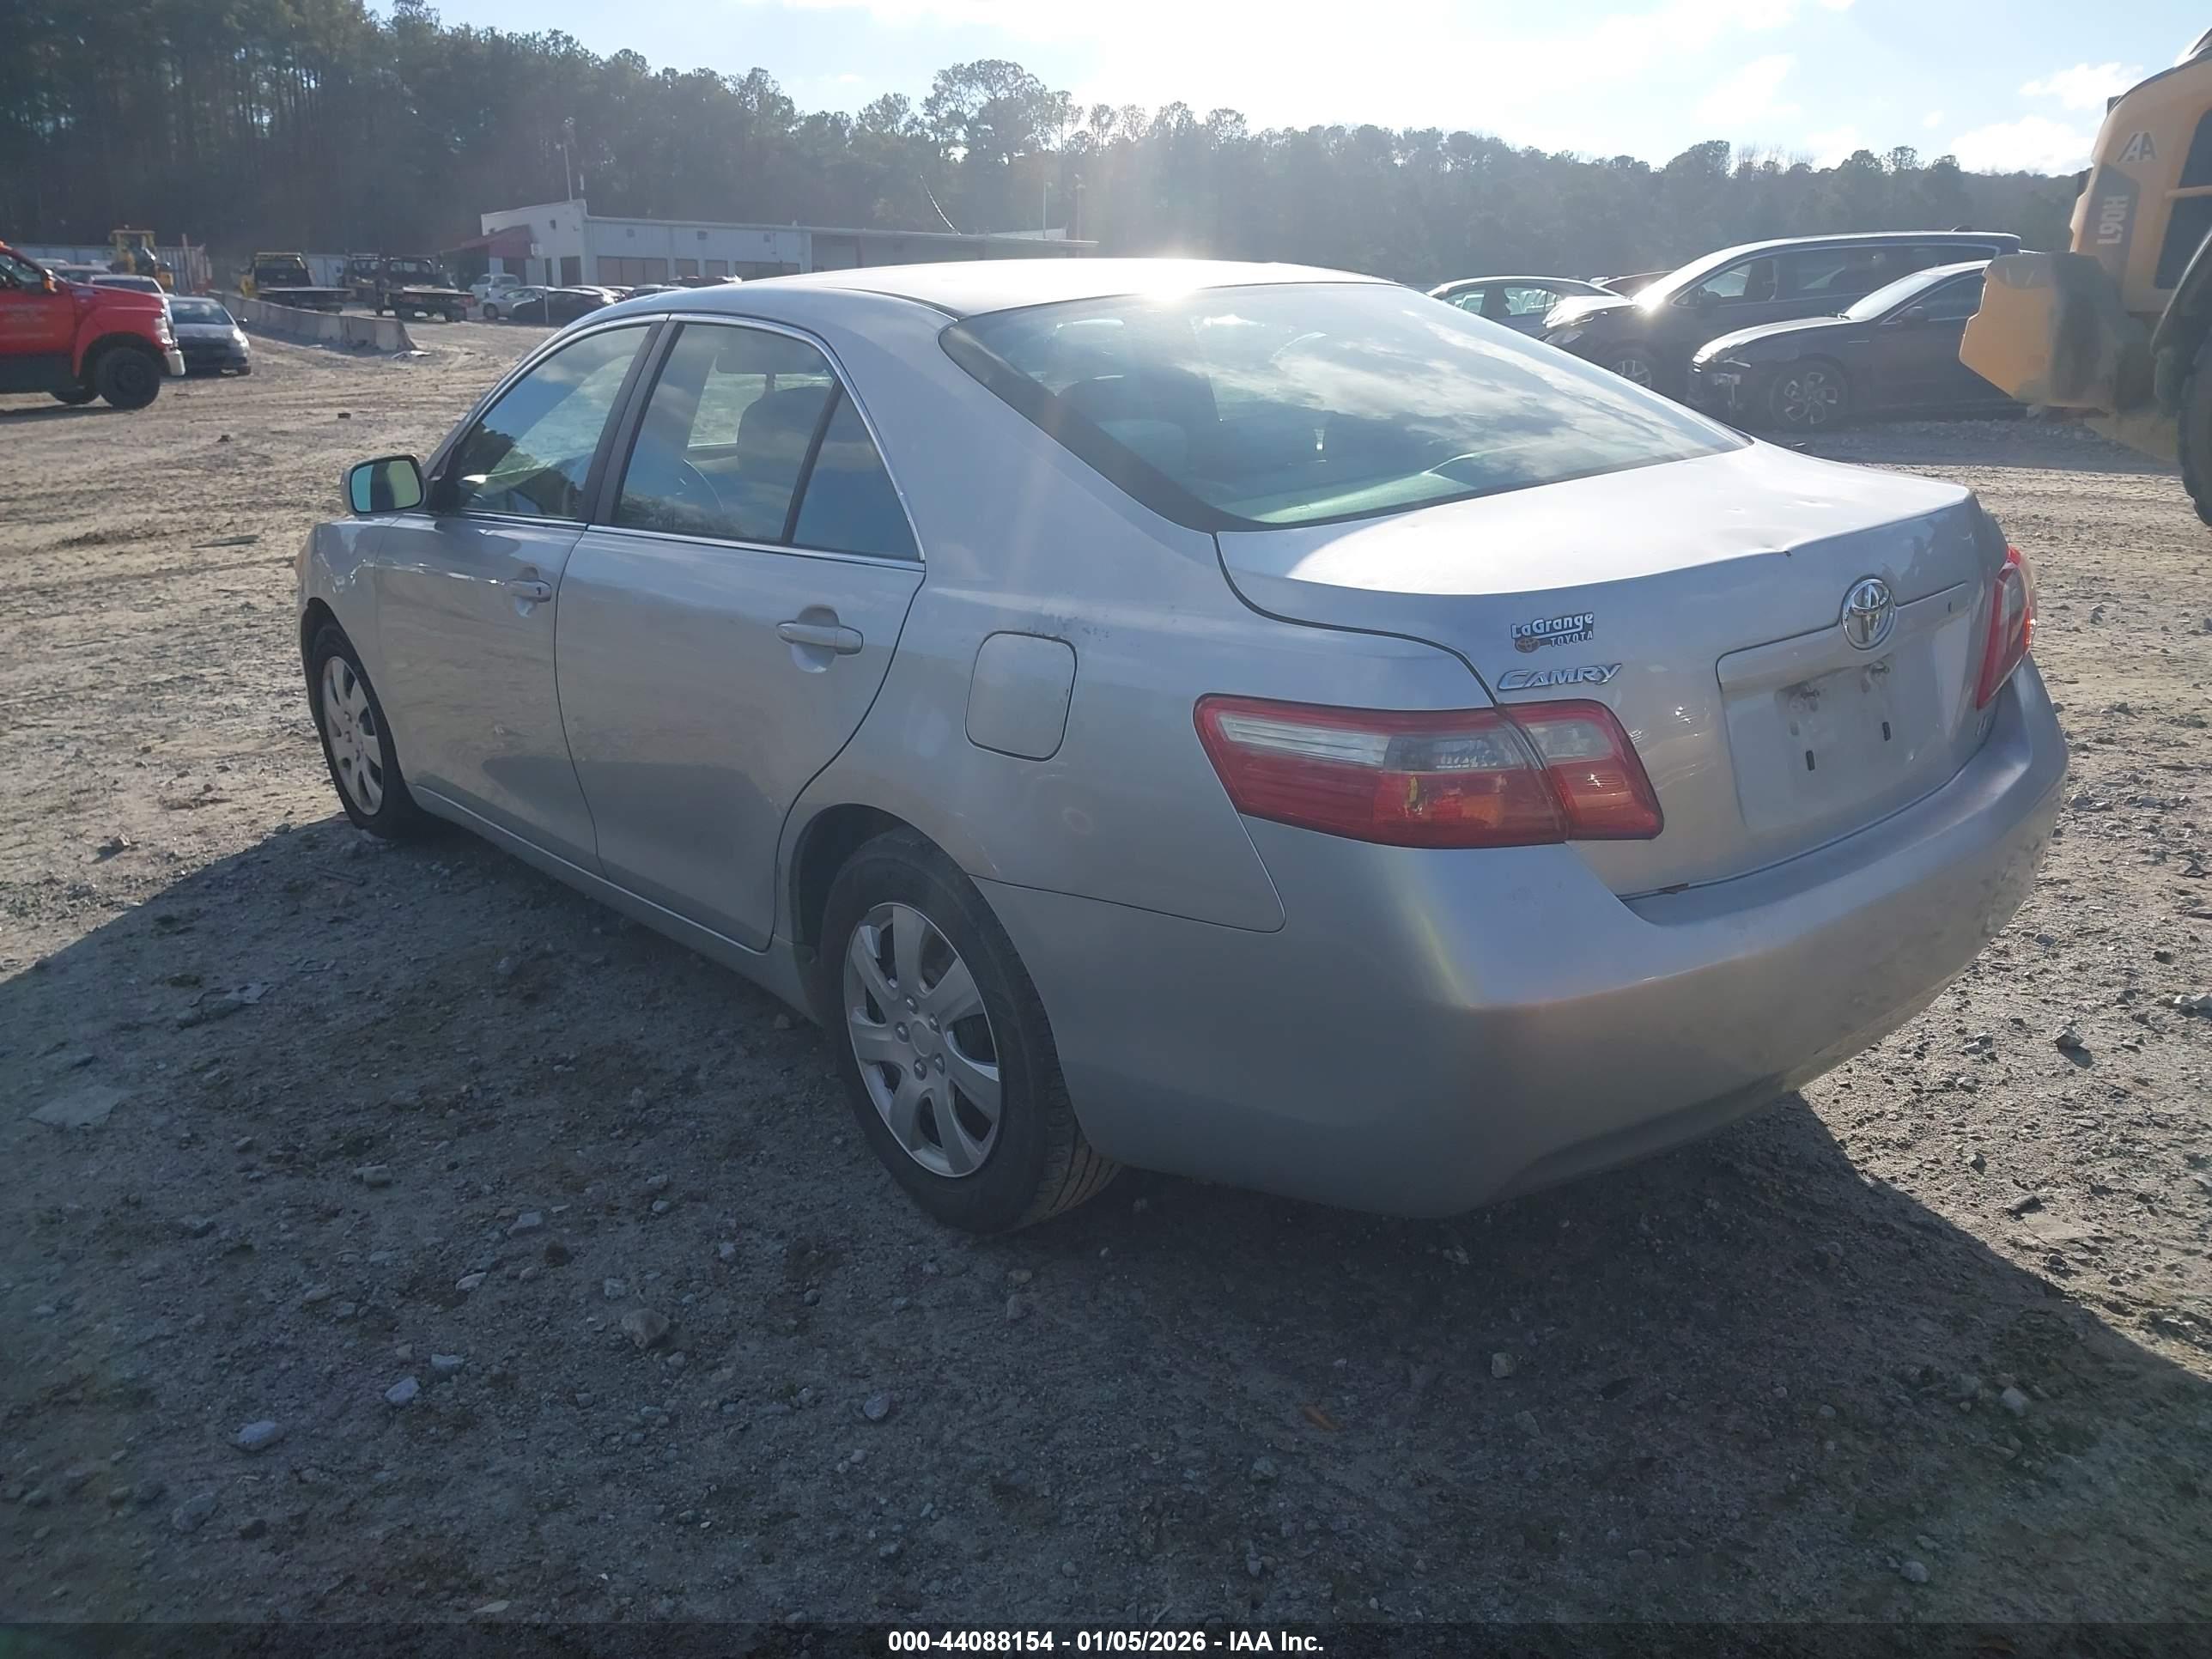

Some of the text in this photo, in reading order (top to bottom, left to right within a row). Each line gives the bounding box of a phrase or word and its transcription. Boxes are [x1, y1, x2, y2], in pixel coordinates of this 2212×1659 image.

[2096, 195, 2130, 245] L90H
[1510, 612, 1594, 640] LaGrange
[1550, 630, 1594, 647] TOYOTA
[1498, 663, 1621, 690] CAMRY
